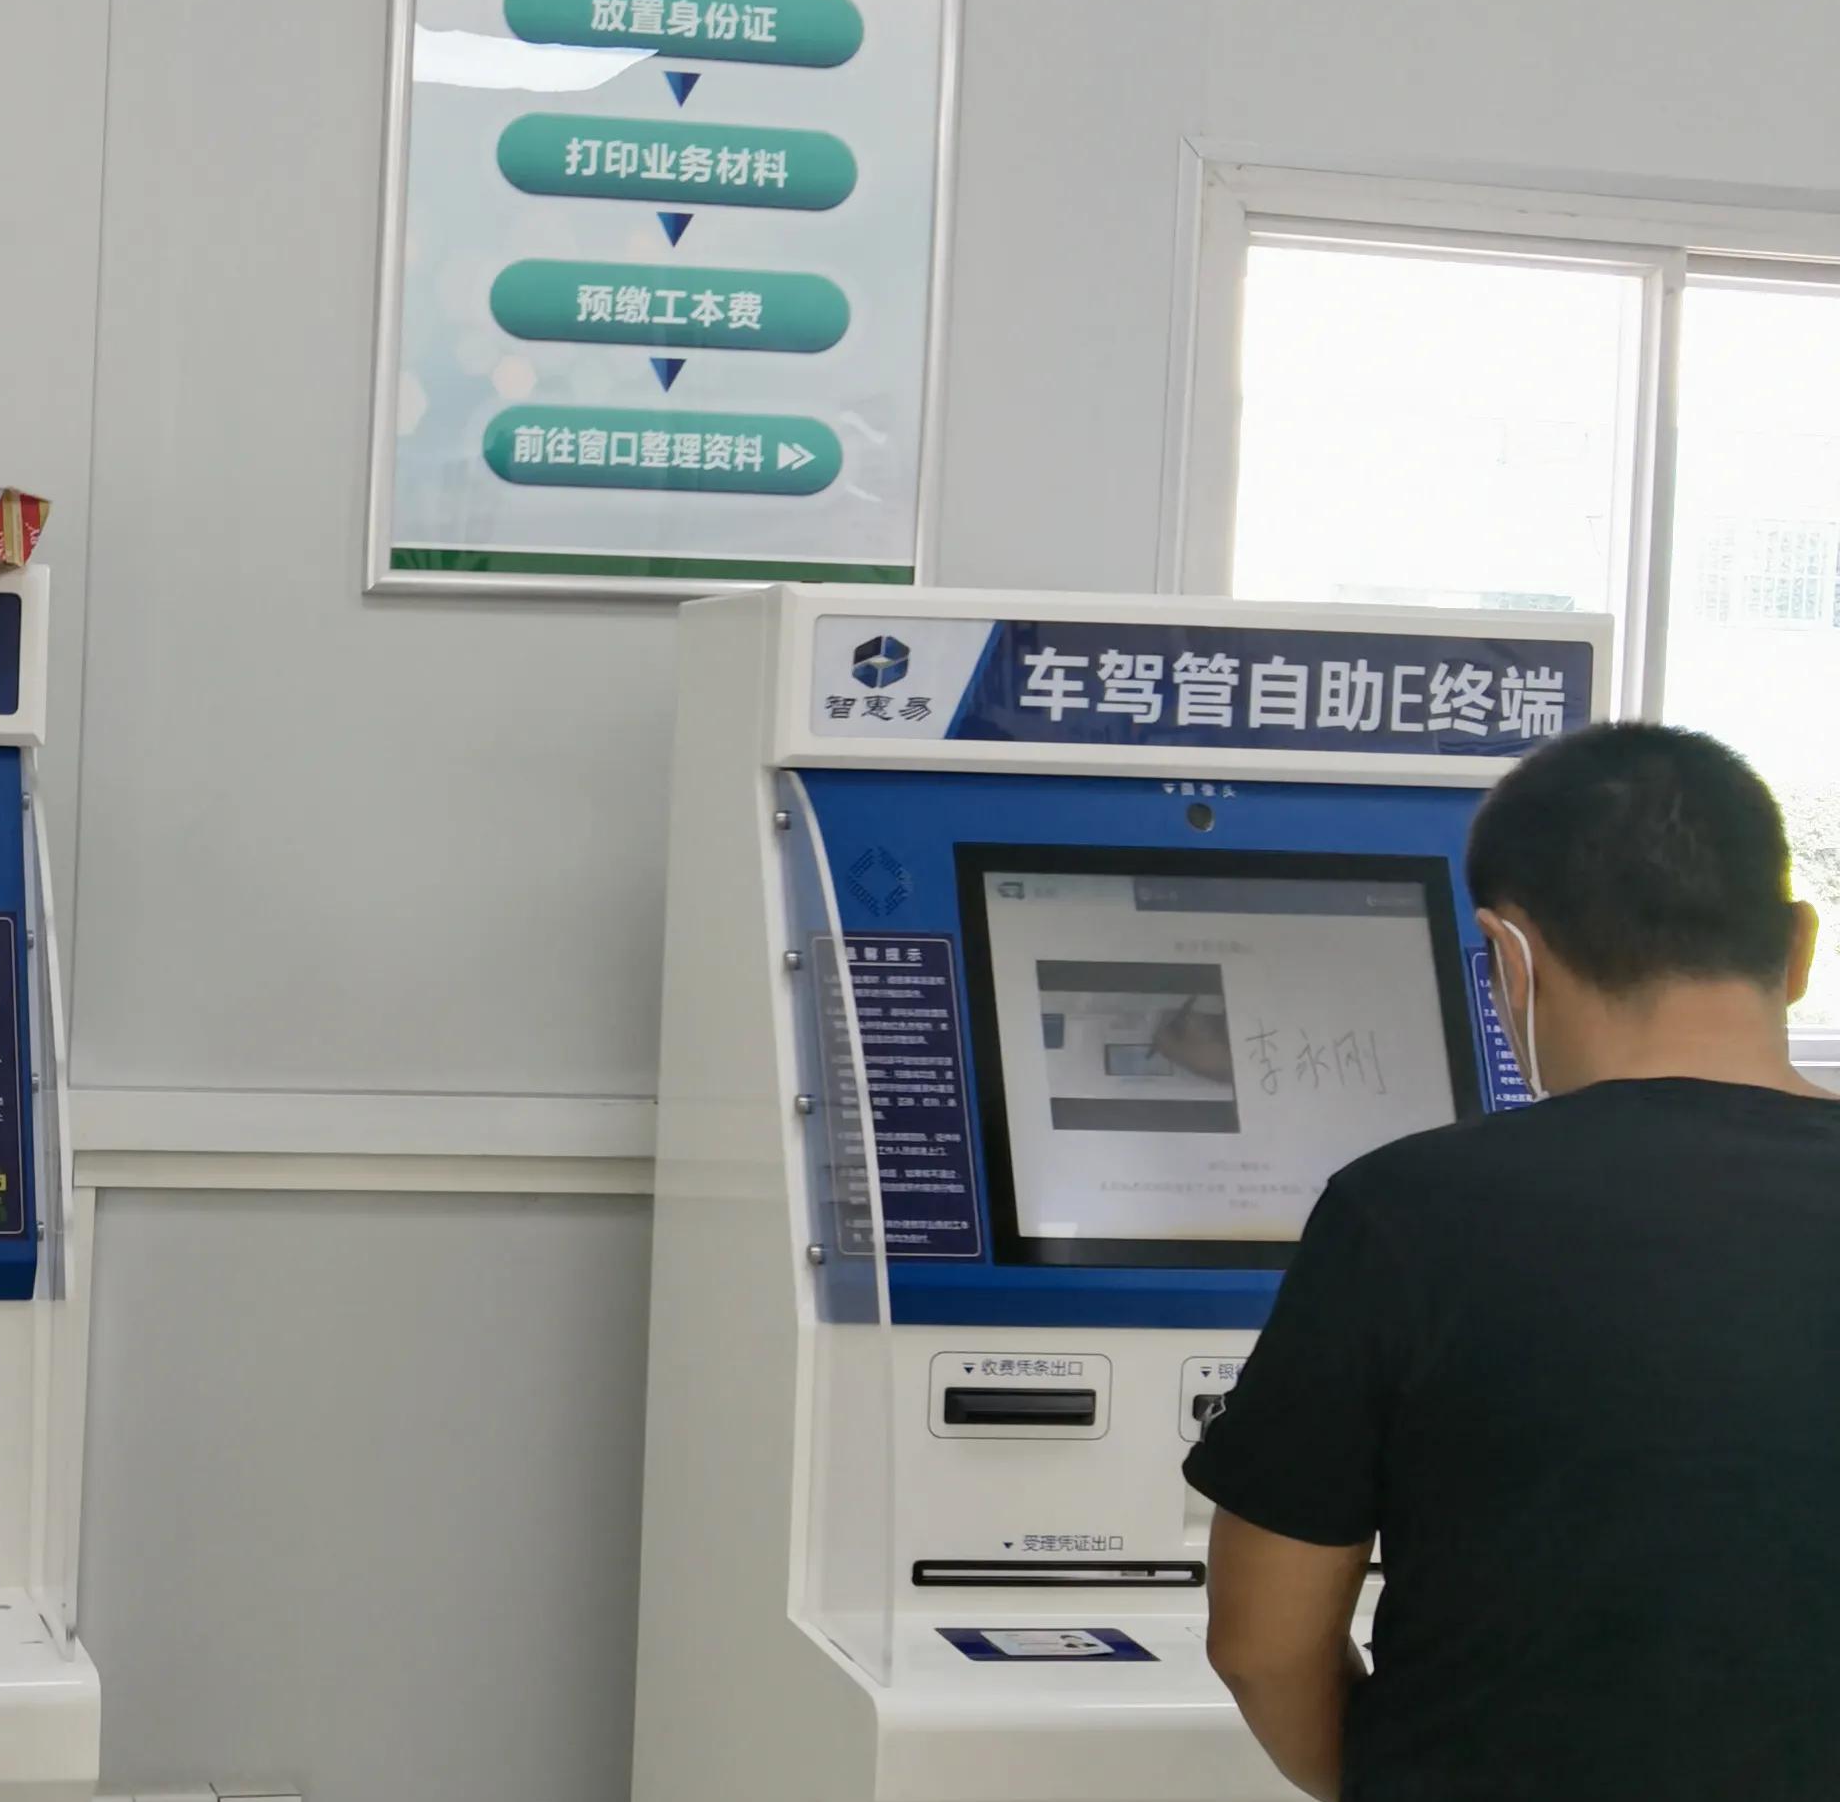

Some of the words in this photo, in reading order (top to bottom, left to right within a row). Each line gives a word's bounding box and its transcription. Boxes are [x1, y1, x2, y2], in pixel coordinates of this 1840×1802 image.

[565, 137, 788, 188] 打印业务材料
[576, 284, 763, 330] 预缴工本费
[514, 426, 764, 472] 前往窗口整理资料
[1019, 646, 1567, 739] 车驾管自助E终端
[981, 1358, 1084, 1377] 收费凭条出口
[1022, 1534, 1125, 1552] 受理凭证出口
